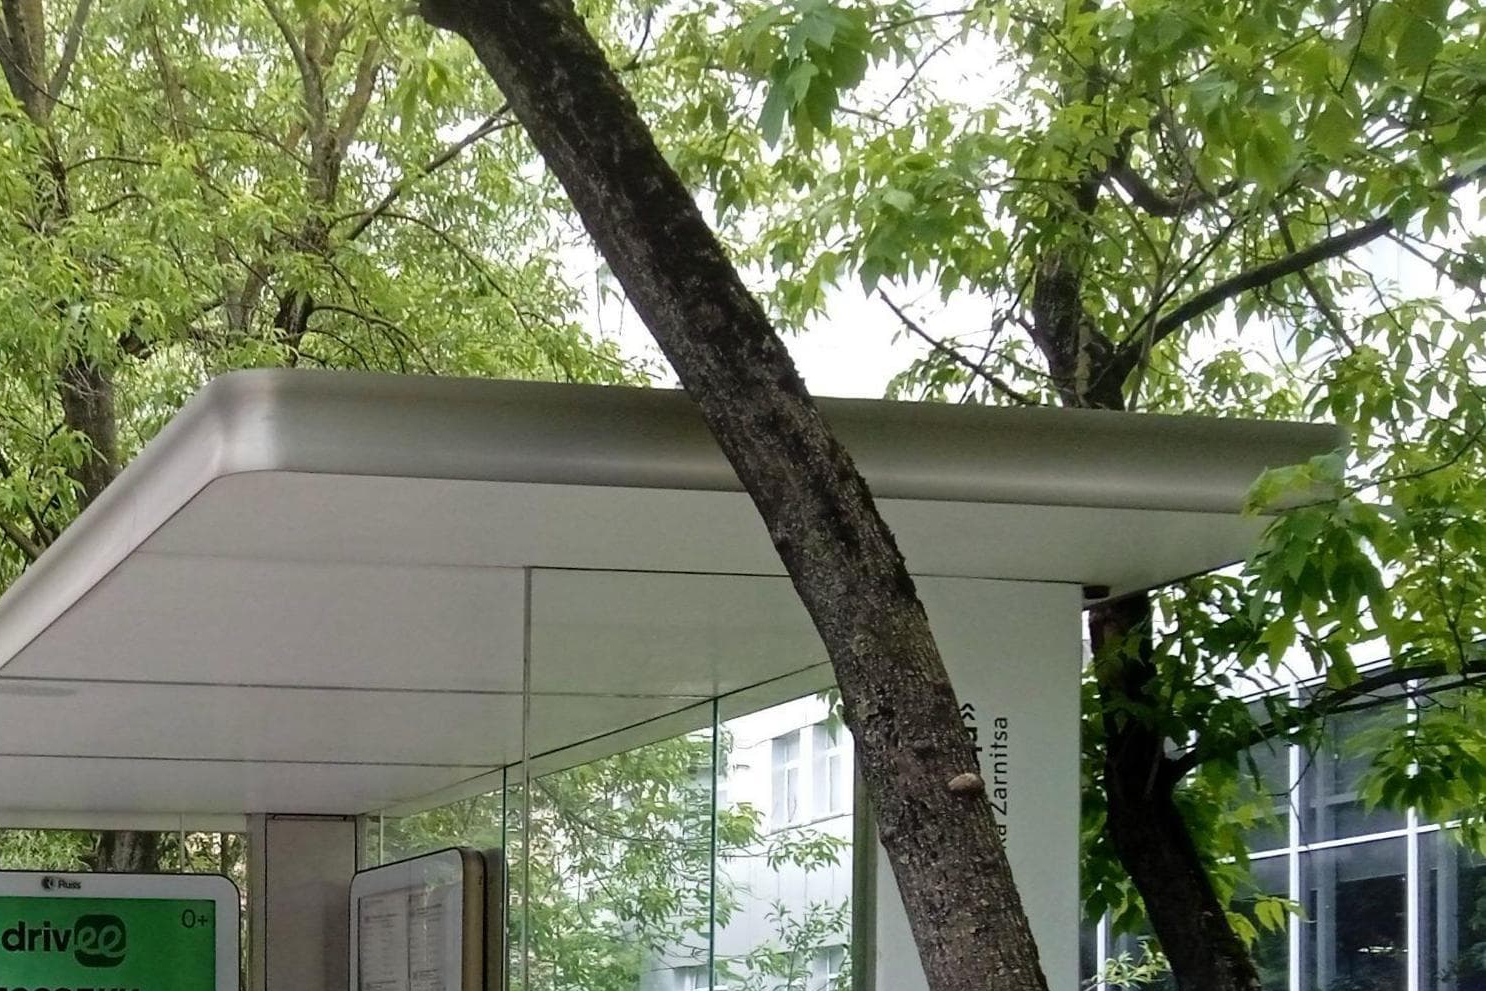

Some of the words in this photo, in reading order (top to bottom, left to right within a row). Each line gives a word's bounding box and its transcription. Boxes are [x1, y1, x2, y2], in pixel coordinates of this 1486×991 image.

[989, 717, 1008, 816] Zarnitsa
[181, 909, 208, 929] 0+
[1, 920, 127, 959] drivee
